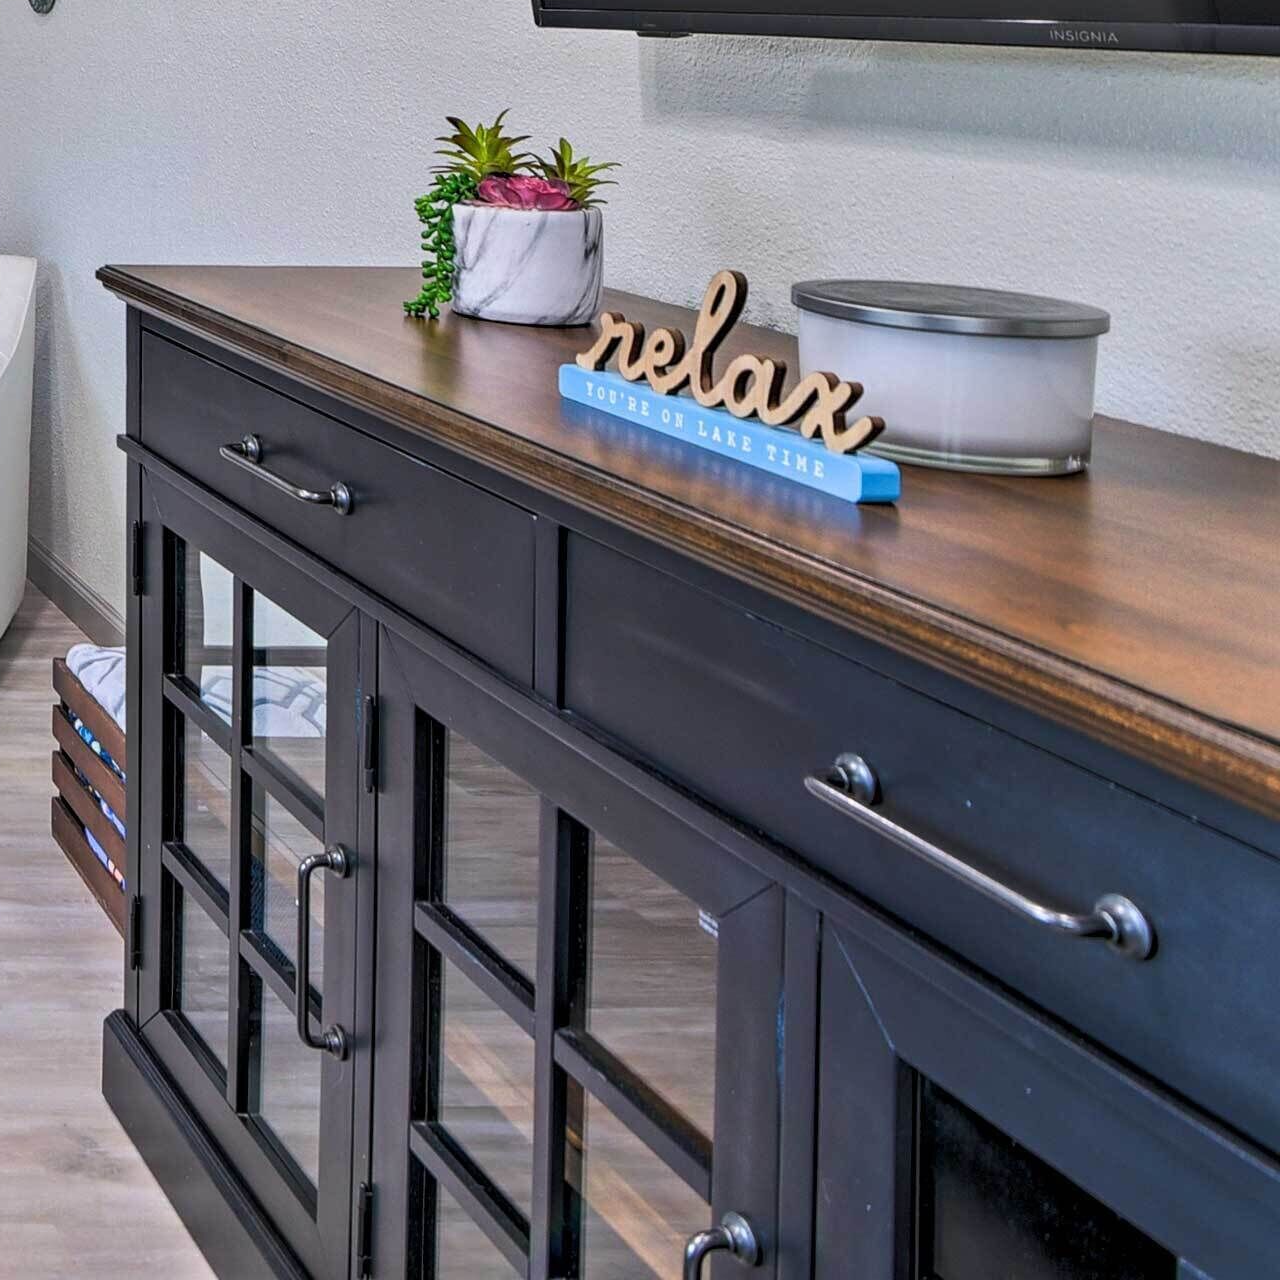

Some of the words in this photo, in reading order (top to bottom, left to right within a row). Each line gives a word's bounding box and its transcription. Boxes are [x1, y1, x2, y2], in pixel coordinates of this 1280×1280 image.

[1049, 29, 1119, 44] INSIGNIA
[576, 269, 885, 453] relax
[585, 380, 651, 417] YOU'RE
[661, 407, 684, 430] ON
[697, 421, 752, 453] LAKE
[766, 443, 825, 479] TIME
